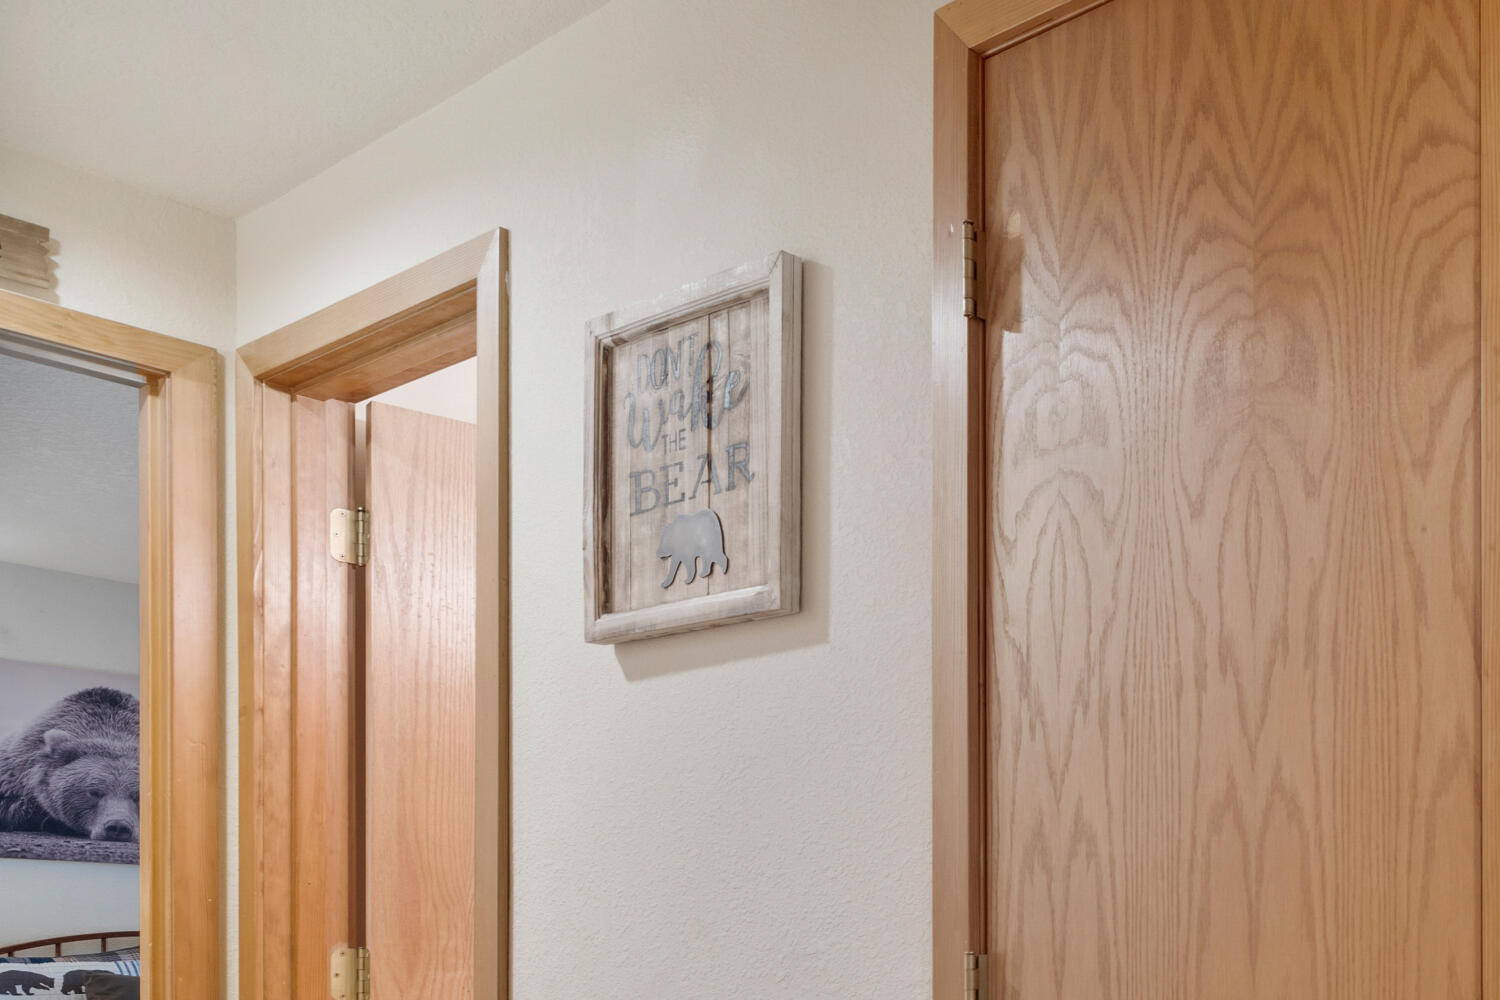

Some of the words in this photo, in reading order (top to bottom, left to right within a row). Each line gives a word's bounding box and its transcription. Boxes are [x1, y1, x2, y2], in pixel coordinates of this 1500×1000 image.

[624, 339, 750, 453] Wake
[629, 441, 755, 517] BEAR
[662, 427, 687, 456] THE
